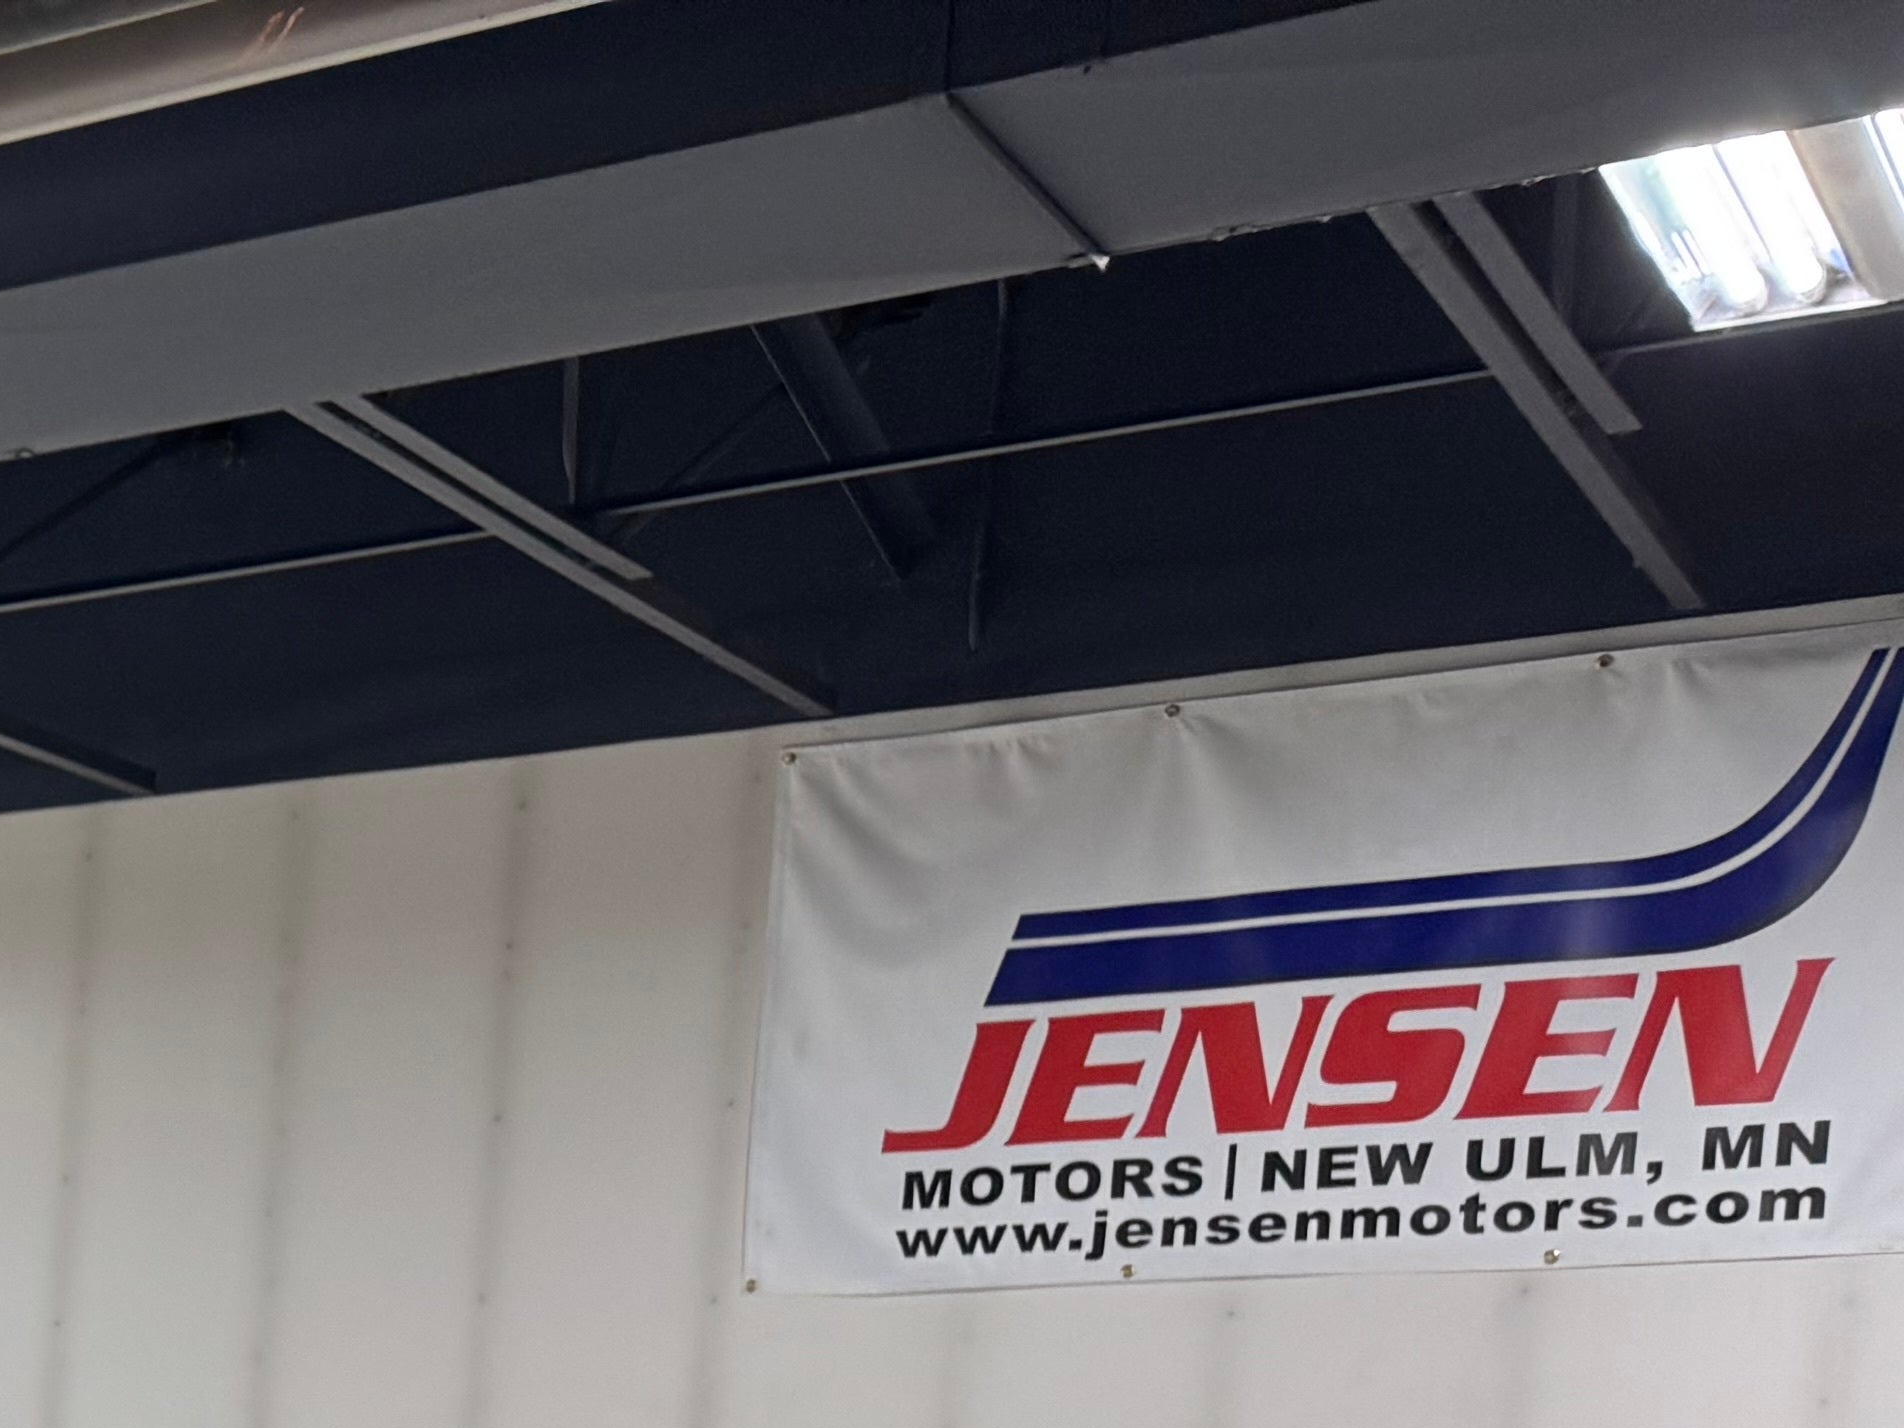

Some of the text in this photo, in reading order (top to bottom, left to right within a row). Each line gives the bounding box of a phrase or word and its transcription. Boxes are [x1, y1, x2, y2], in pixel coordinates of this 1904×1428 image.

[880, 956, 1836, 1155] JENSEN
[899, 1119, 1832, 1211] MOTORS NEW ULM, MN
[896, 1184, 1828, 1261] www.jensenmotors.com
